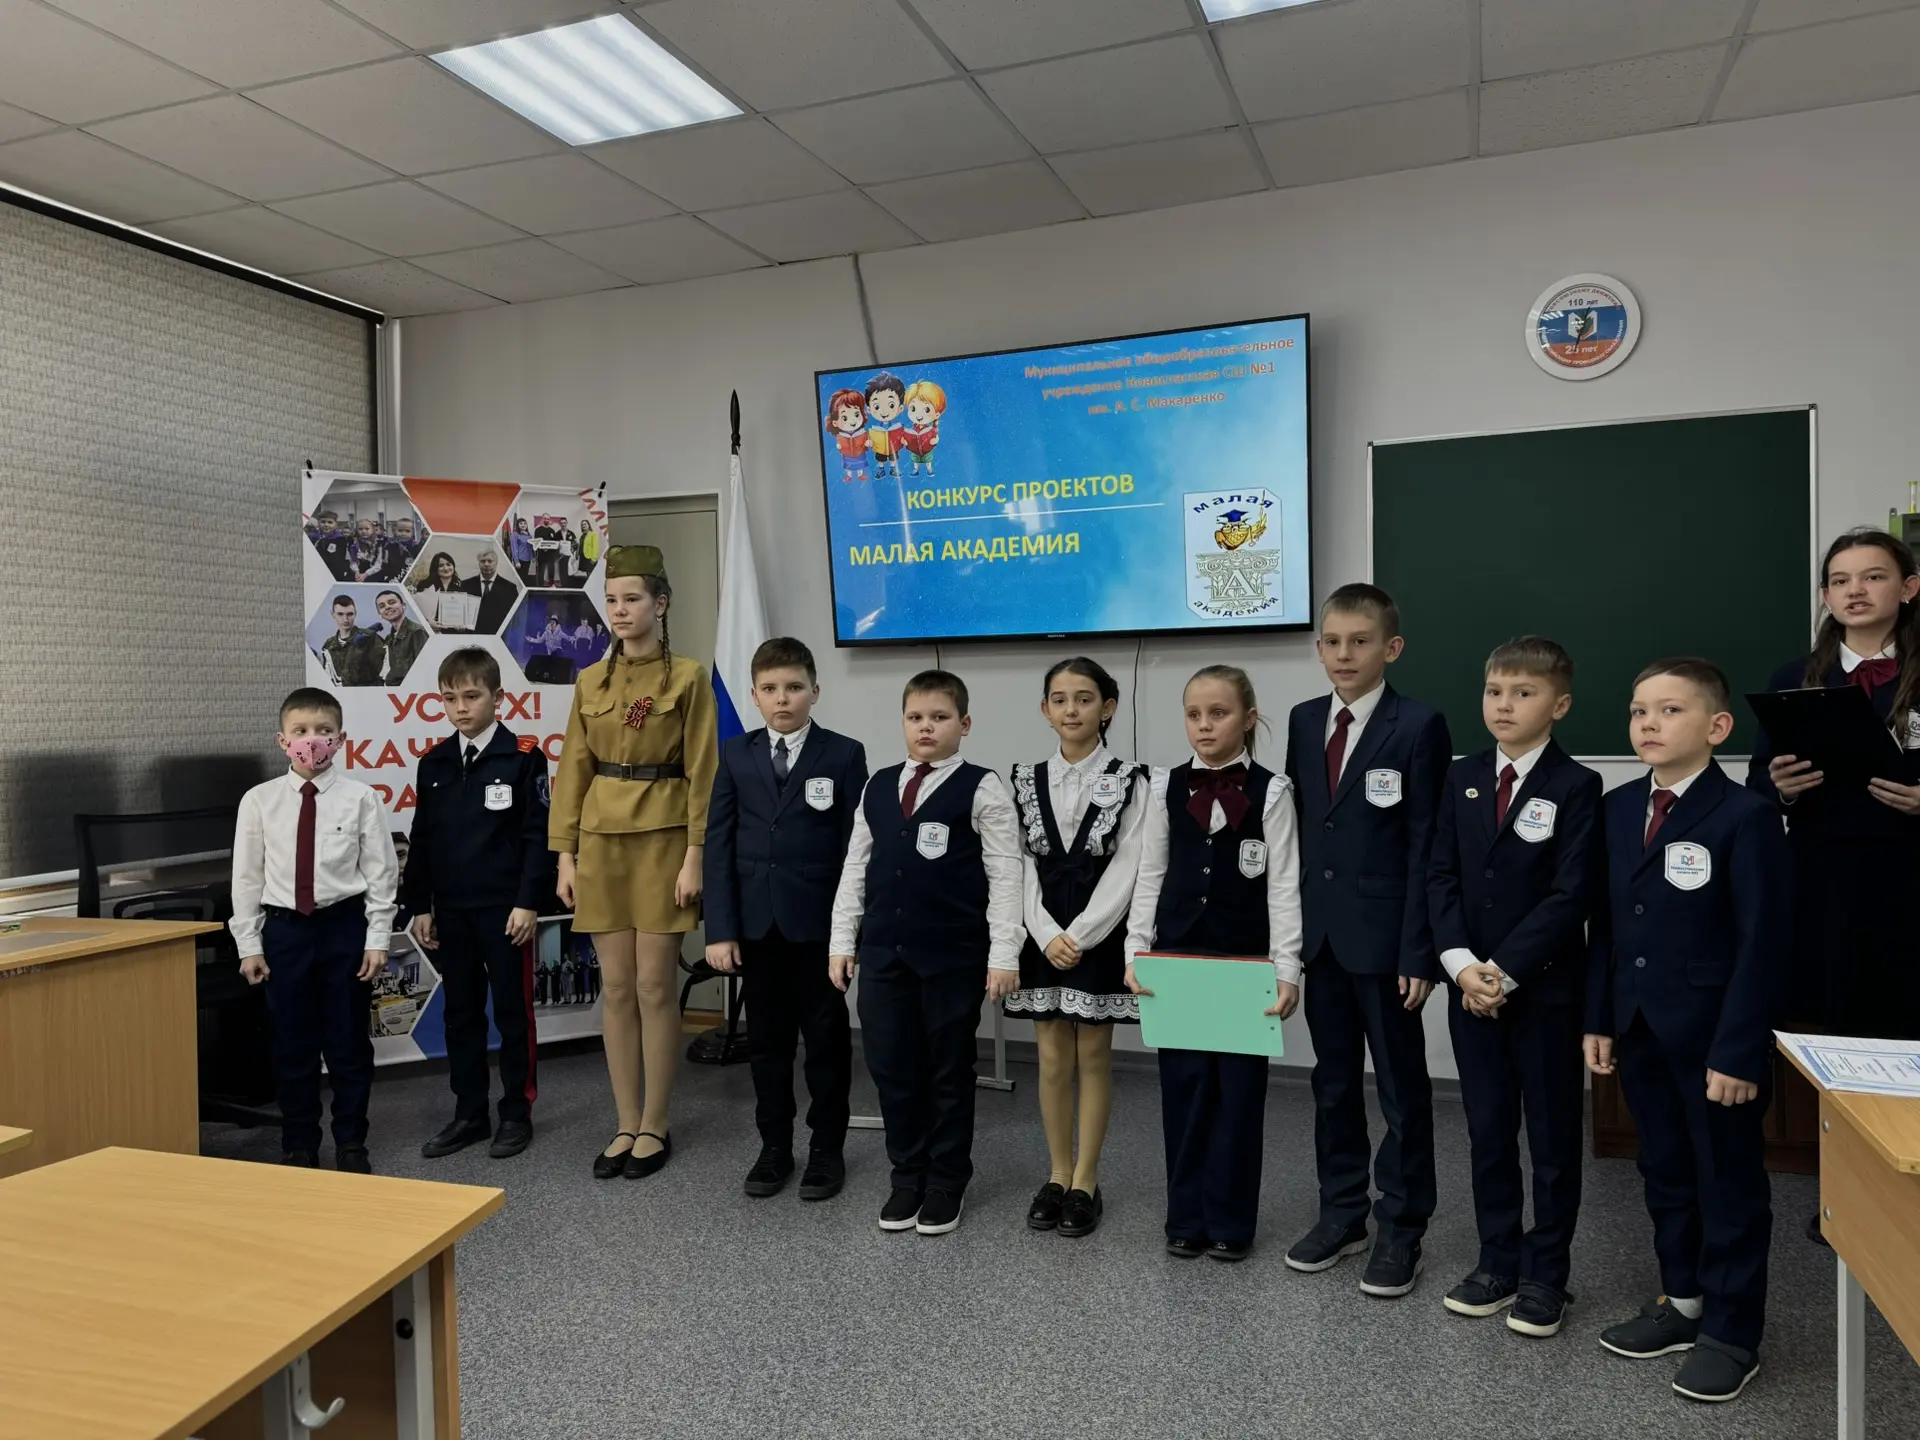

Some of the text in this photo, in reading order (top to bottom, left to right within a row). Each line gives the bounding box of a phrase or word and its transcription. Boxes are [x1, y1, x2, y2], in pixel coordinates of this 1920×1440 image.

[1568, 298, 1599, 307] 110 лет
[1025, 337, 1296, 380] Муниципальное общеобразовательное
[1581, 345, 1599, 354] лет
[1041, 378, 1122, 401] учреждение
[1222, 364, 1246, 380] СШ
[1250, 360, 1276, 377] №1
[1114, 399, 1128, 414] А.
[1147, 389, 1227, 411] Макаренко
[906, 473, 1135, 511] КОНКУРС ПРОЕКТОВ
[1192, 493, 1275, 515] малая
[849, 531, 1081, 567] МАЛАЯ АКАДЕМИЯ
[1193, 595, 1280, 618] академия
[387, 691, 542, 724] УСХ!
